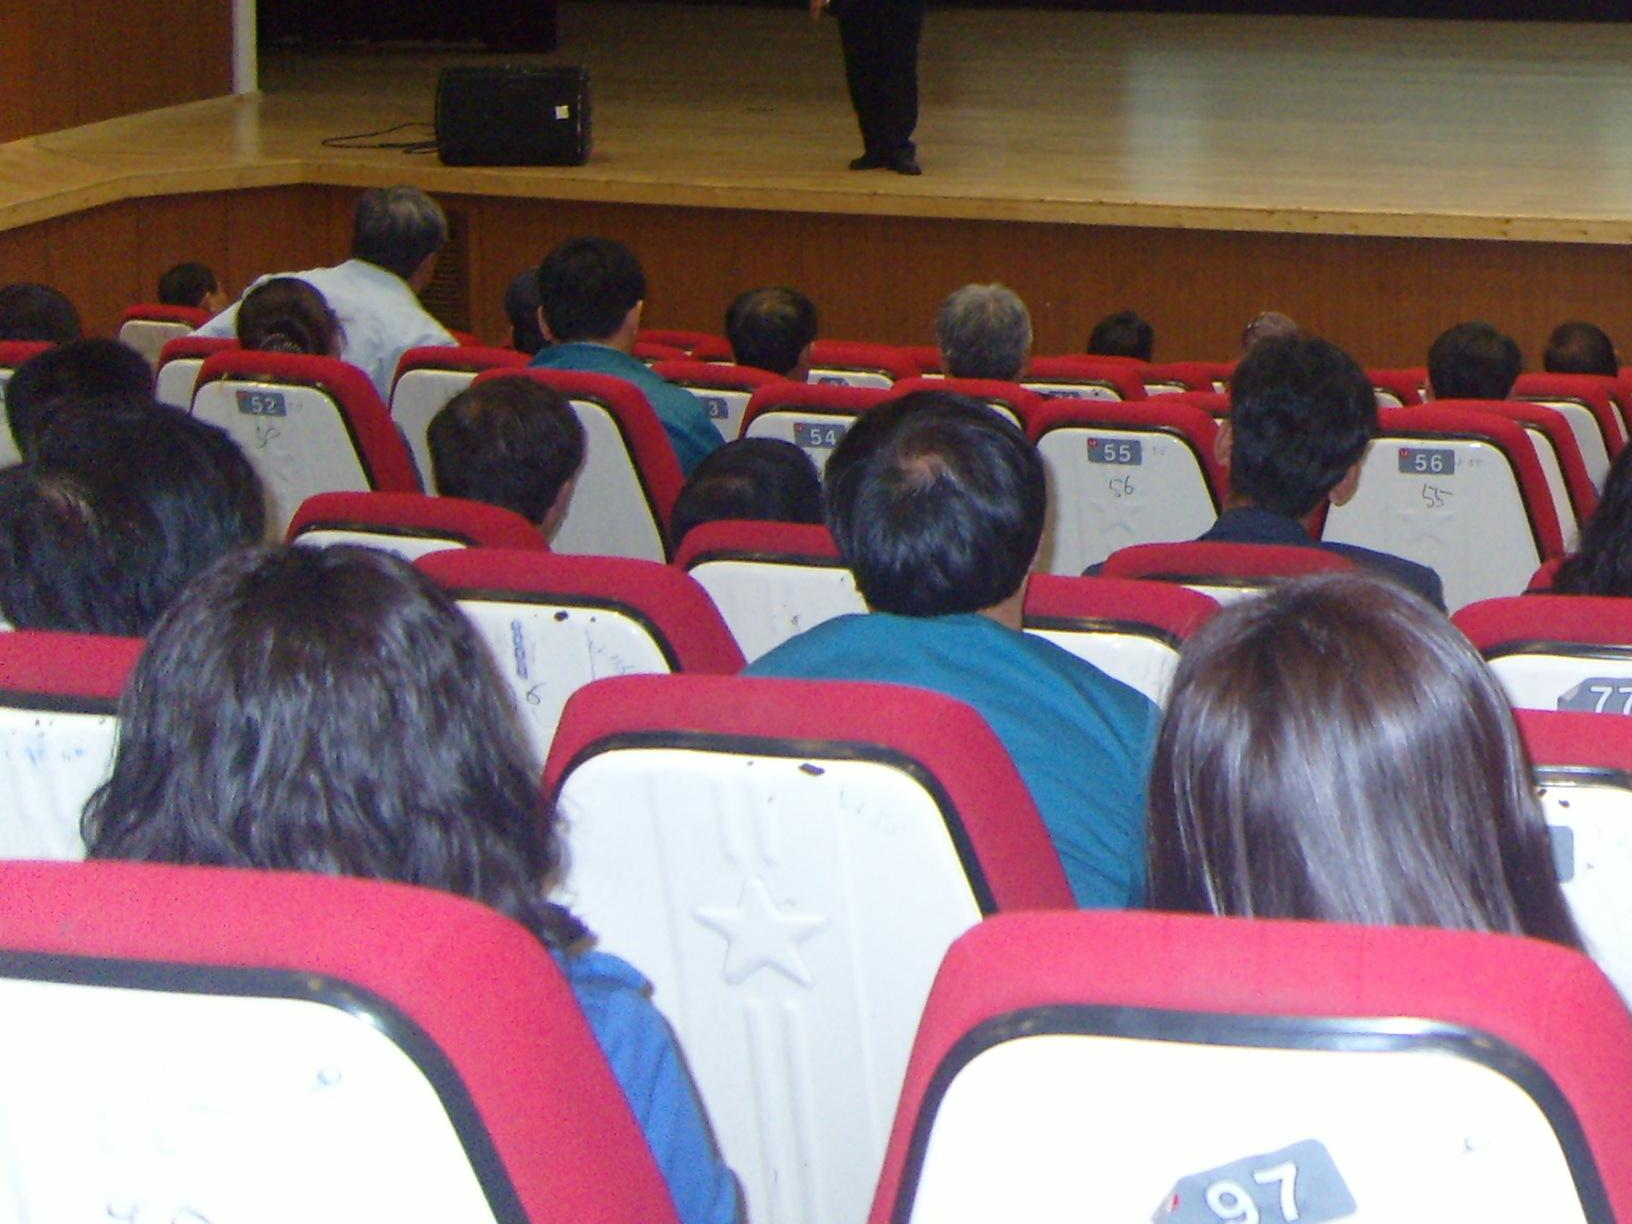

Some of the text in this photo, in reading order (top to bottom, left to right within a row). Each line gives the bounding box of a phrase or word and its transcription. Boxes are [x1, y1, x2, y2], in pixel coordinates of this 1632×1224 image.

[810, 428, 836, 446] 54
[1104, 443, 1131, 462] 55
[1415, 453, 1444, 473] 56
[1205, 1160, 1302, 1224] 97
